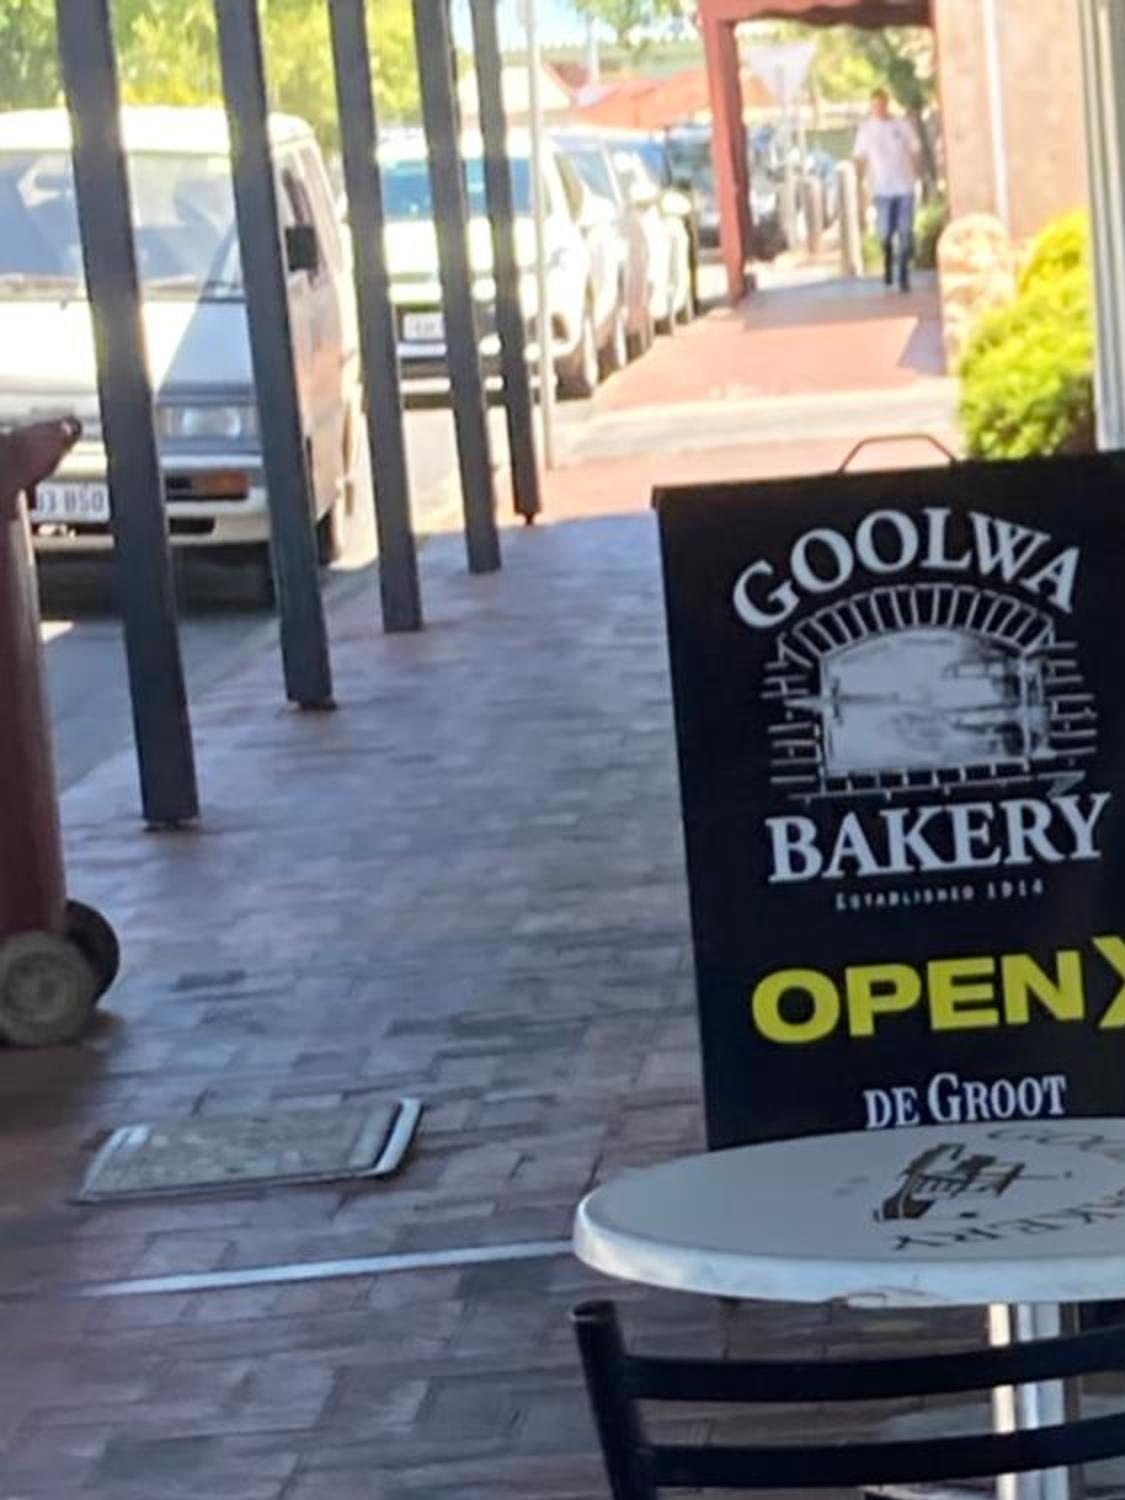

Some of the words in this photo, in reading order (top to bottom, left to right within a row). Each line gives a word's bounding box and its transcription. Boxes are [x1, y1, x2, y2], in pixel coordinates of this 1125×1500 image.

[733, 508, 1080, 628] GOOLWA
[765, 792, 1112, 884] BAKERY
[751, 950, 1085, 1043] OPEN
[863, 1087, 920, 1129] DE
[927, 1072, 1067, 1122] GROOT
